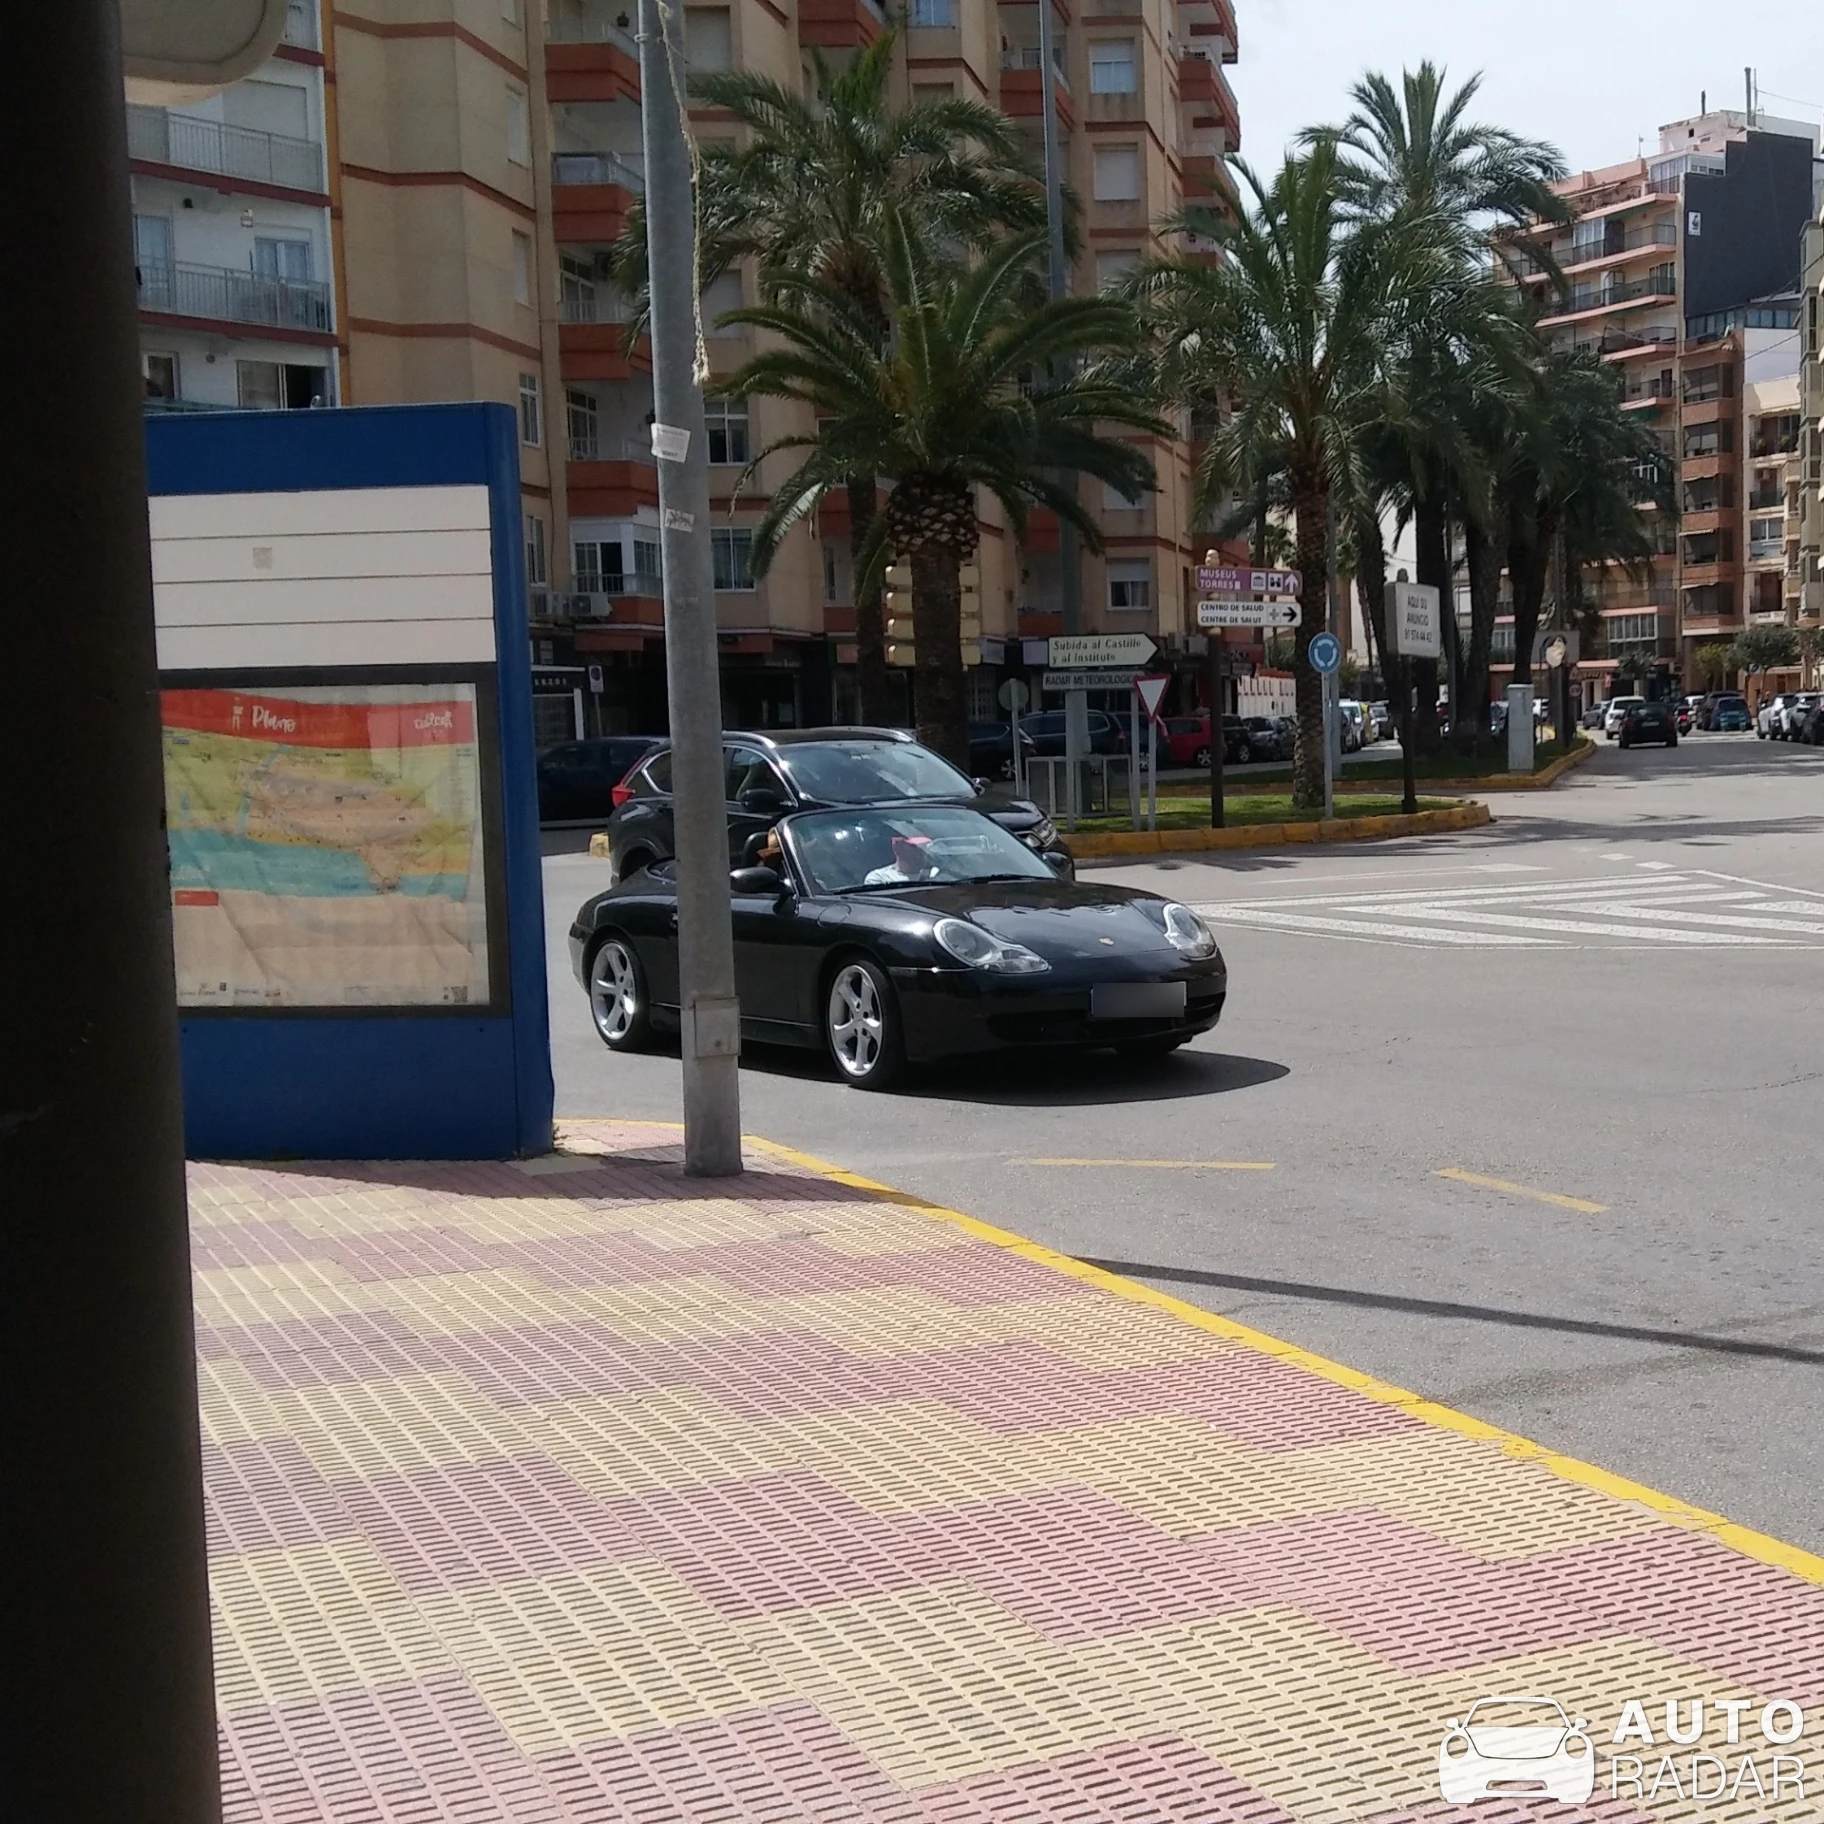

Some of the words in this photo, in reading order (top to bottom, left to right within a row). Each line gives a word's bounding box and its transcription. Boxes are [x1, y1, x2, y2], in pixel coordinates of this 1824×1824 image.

[1200, 569, 1237, 579] MUSEUS
[1200, 579, 1234, 589] TORRES
[1200, 603, 1229, 611] CENTRO
[1241, 604, 1264, 612] SALUD
[1406, 612, 1429, 626] ANUNCIO
[1053, 639, 1088, 651] Subida
[1091, 639, 1101, 649] al
[1105, 638, 1141, 648] Castillo
[1052, 655, 1058, 665] y
[1061, 653, 1071, 663] al
[1074, 653, 1116, 663] Instituto
[1045, 676, 1071, 685] RADAR
[1074, 674, 1132, 684] METEOROLOGIC
[252, 705, 297, 734] Plano
